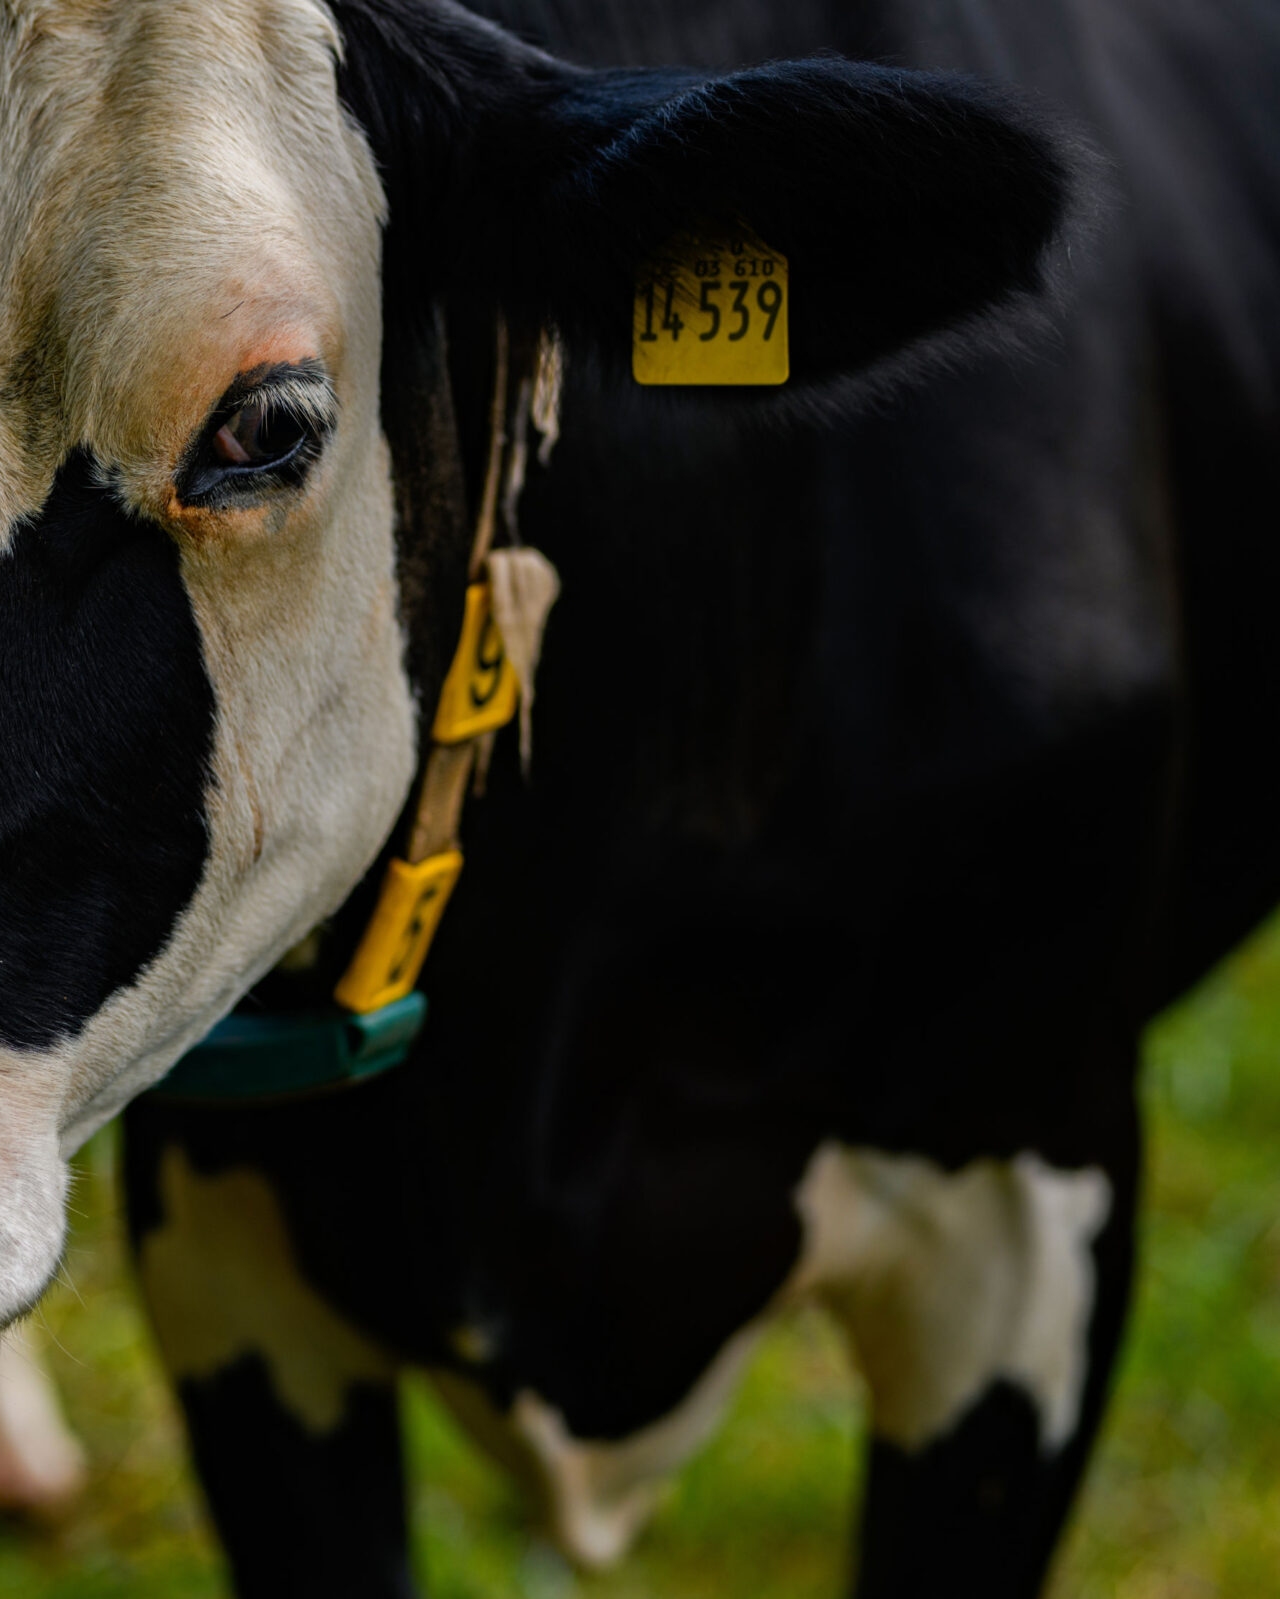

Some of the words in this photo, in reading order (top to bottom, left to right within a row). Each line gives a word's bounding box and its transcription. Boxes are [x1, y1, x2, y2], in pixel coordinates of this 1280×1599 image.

[696, 259, 720, 277] 03
[735, 259, 774, 277] 610
[639, 281, 684, 342] 14
[698, 280, 783, 342] 539
[469, 610, 506, 706] 9
